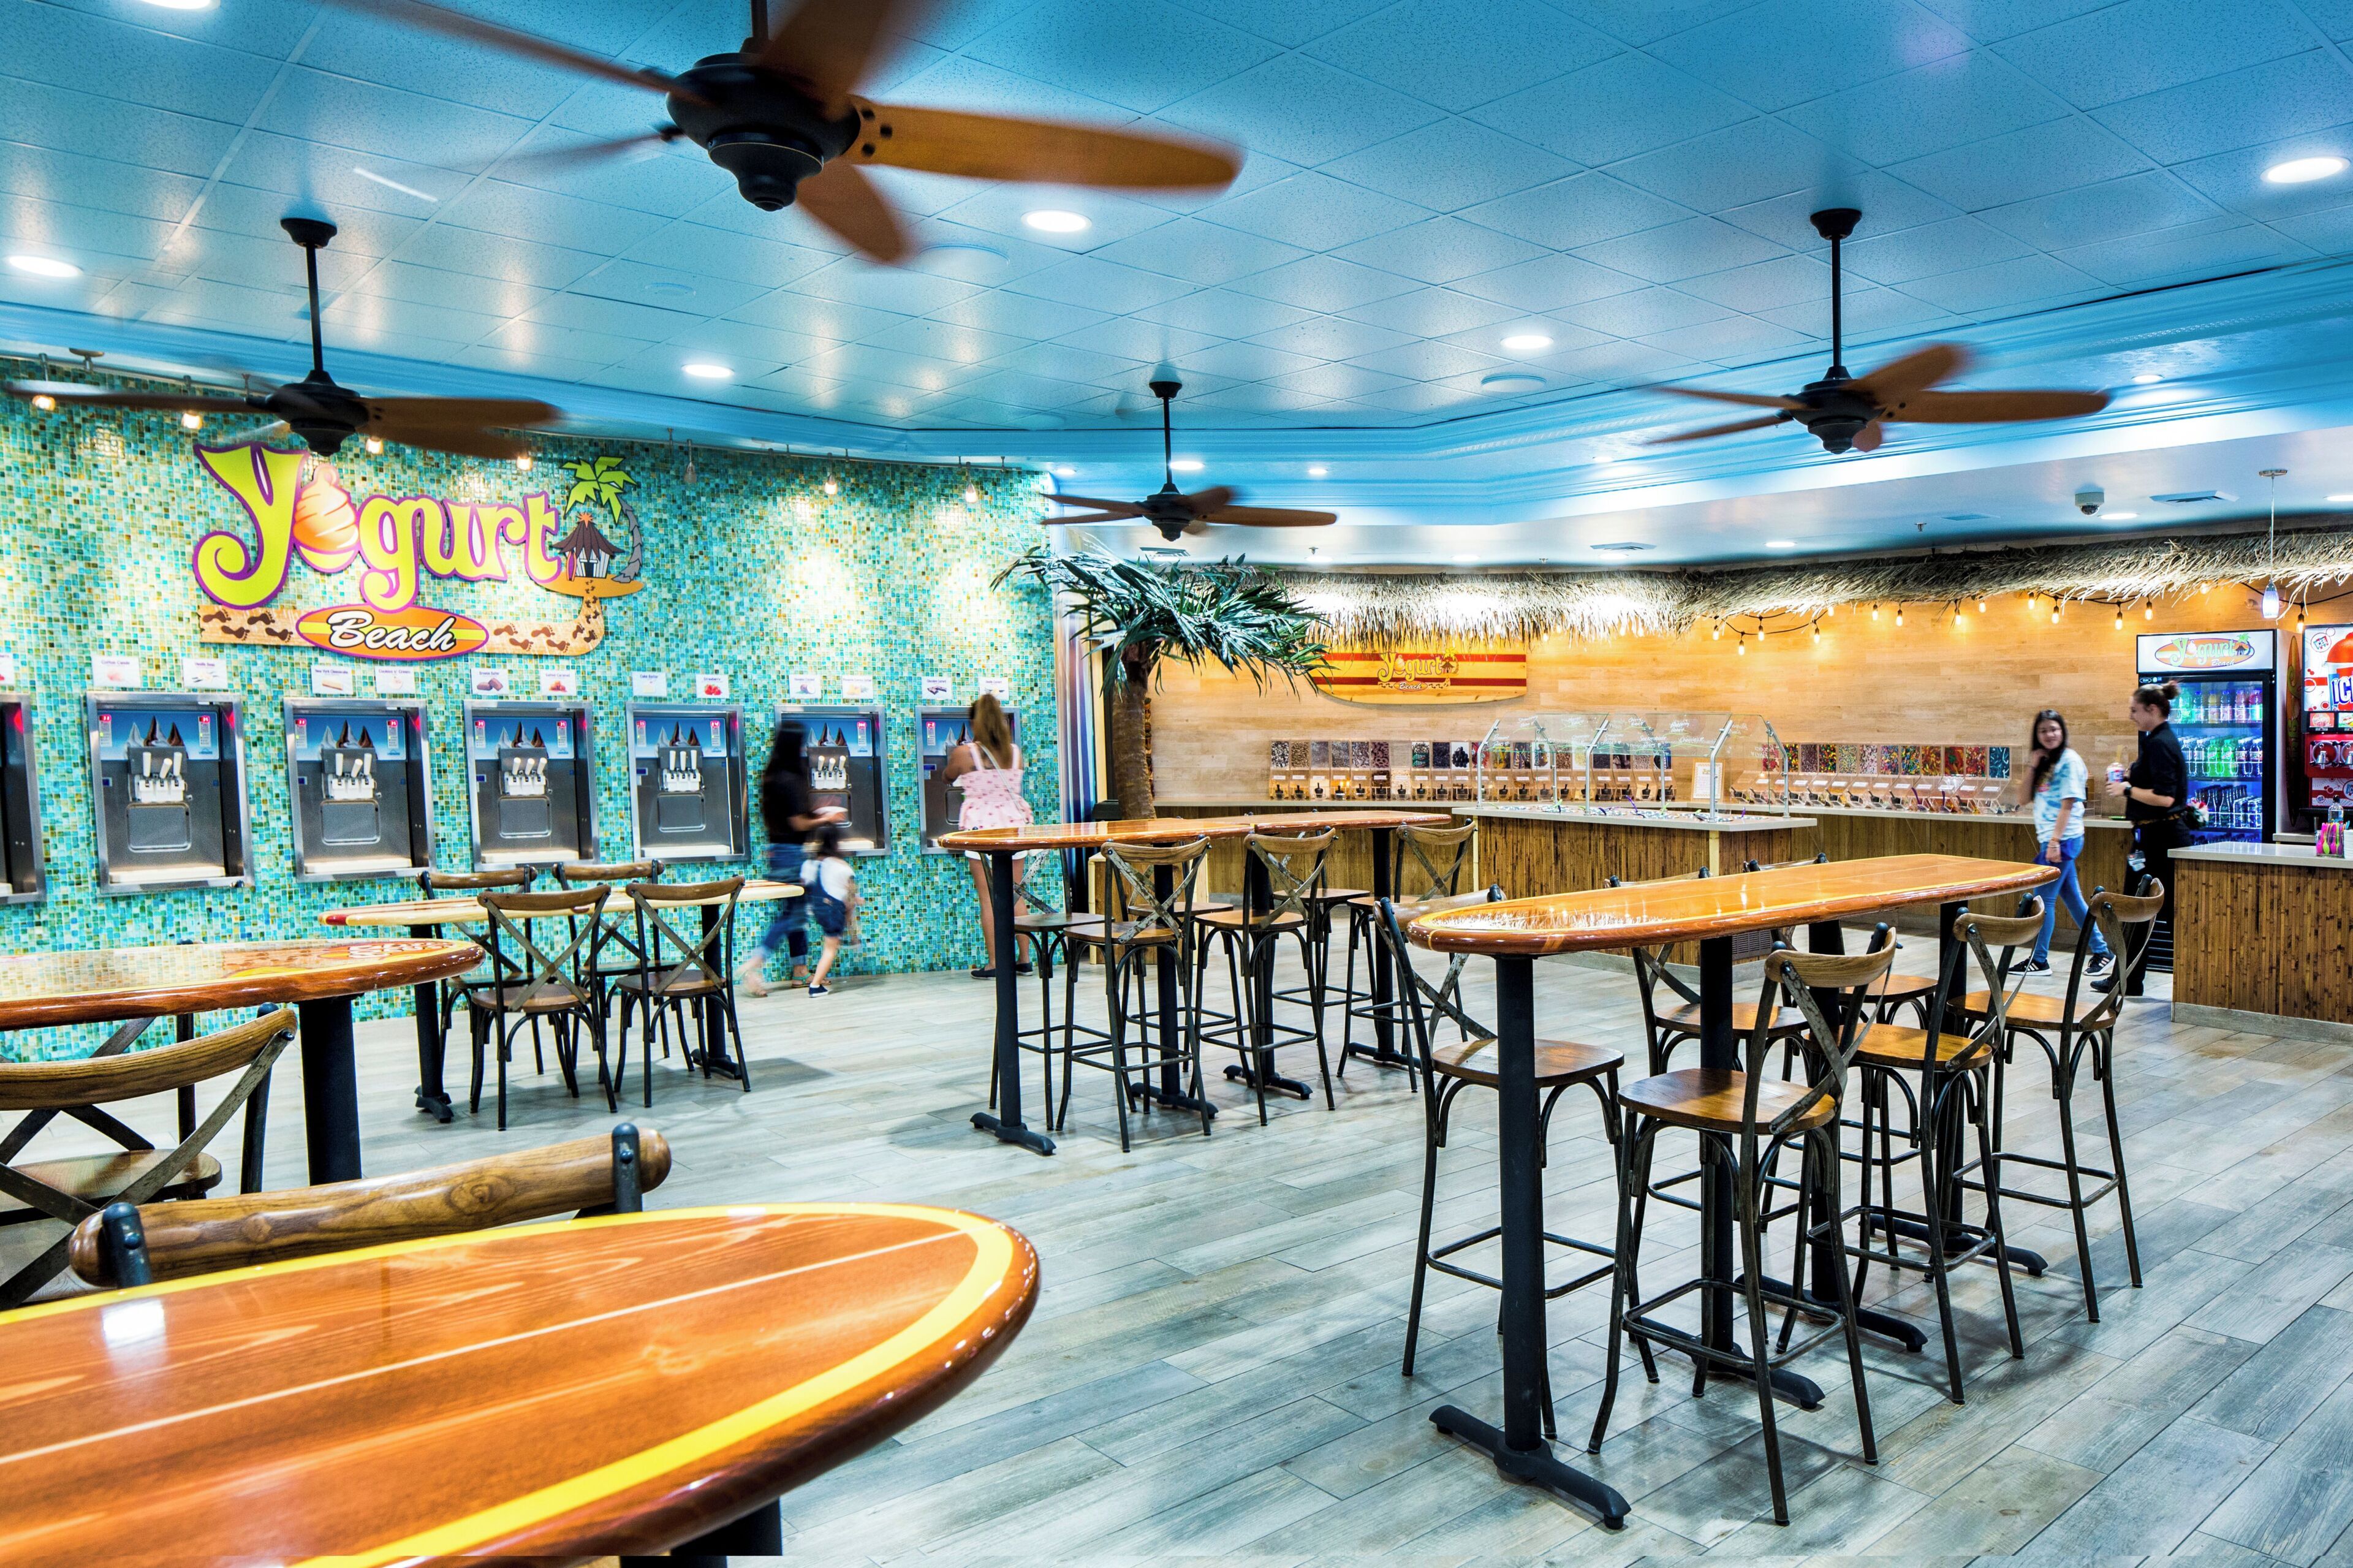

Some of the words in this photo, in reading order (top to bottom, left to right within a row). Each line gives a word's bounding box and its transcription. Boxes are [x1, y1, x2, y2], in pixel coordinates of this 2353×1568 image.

[192, 442, 562, 612] Yogurt
[326, 610, 457, 653] Beach
[2169, 637, 2237, 667] Yogurt
[1377, 652, 1442, 683] Yogurt
[1399, 682, 1422, 691] Beach
[2331, 676, 2353, 705] IC
